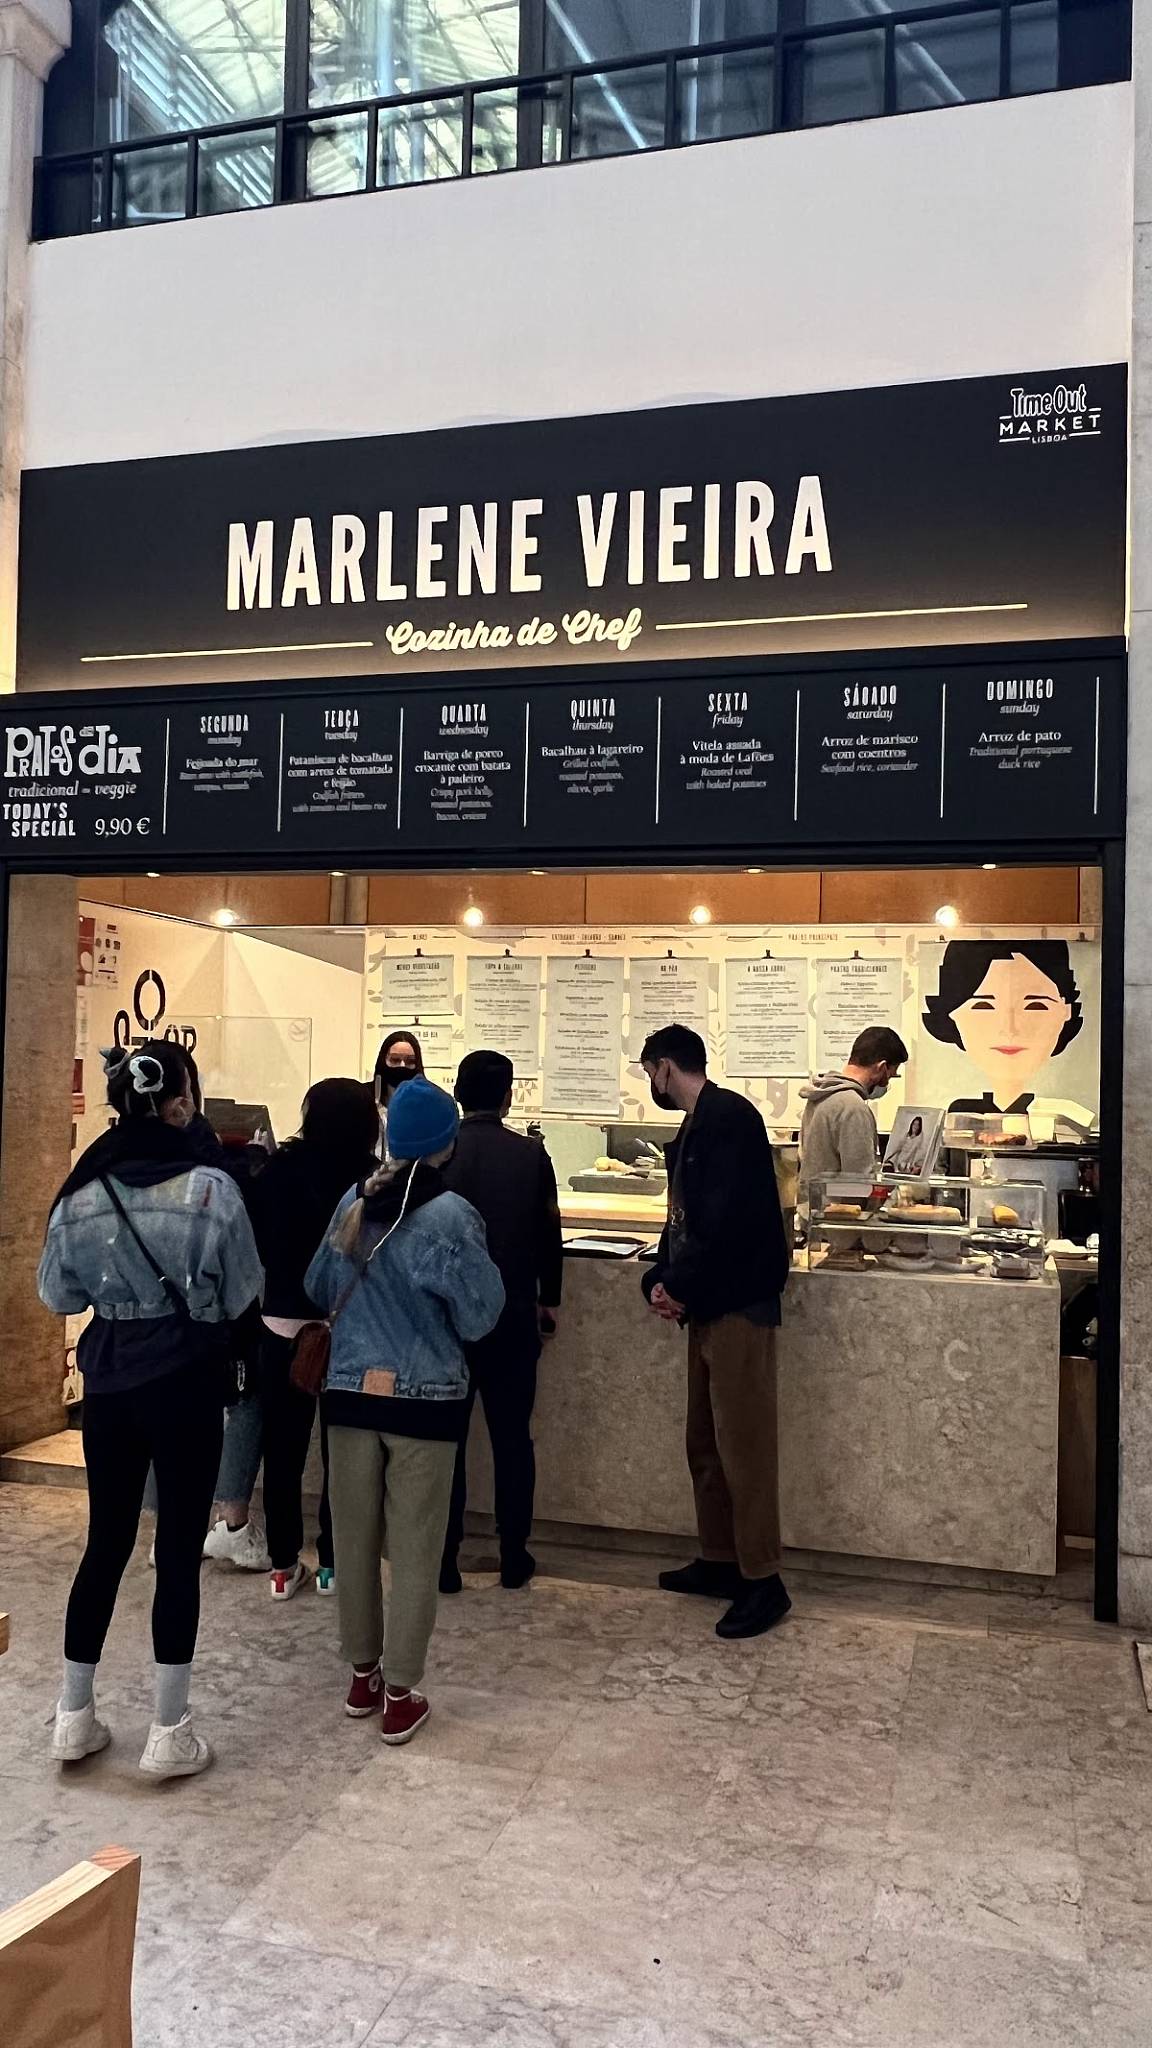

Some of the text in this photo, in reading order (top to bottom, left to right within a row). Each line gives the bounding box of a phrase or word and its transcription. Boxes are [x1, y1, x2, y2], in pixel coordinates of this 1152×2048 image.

[1010, 384, 1087, 417] Time Out
[1000, 415, 1101, 436] MARKET
[1031, 434, 1068, 444] LISBOA
[227, 475, 832, 611] MARLENE VIEIRA
[386, 607, 643, 655] Cozinha de Chef
[986, 678, 1054, 701] DOMINGO
[570, 698, 616, 721] QUINTA
[707, 692, 748, 712] SEXTA
[999, 700, 1041, 717] sunday
[441, 703, 487, 725] QUARTA
[712, 711, 744, 729] friday
[846, 705, 893, 722] saturday
[200, 714, 249, 733] SEGUNDA
[572, 718, 614, 734] thursday
[692, 739, 723, 750] Vitela
[821, 733, 919, 747] Arroz de marisco
[978, 729, 1062, 744] Arroz de pato
[423, 749, 503, 762] Barriga de porco
[541, 746, 587, 757] Bacalhau
[597, 744, 644, 758] lagareiro
[689, 752, 719, 764] moda
[721, 752, 735, 763] de
[831, 749, 907, 760] com coentros
[458, 763, 479, 772] com
[8, 780, 80, 798] tradicional
[94, 781, 137, 800] veggie
[2, 802, 69, 820] TODAY'S
[11, 819, 77, 838] SPECIAL
[94, 817, 151, 839] 9,90 €
